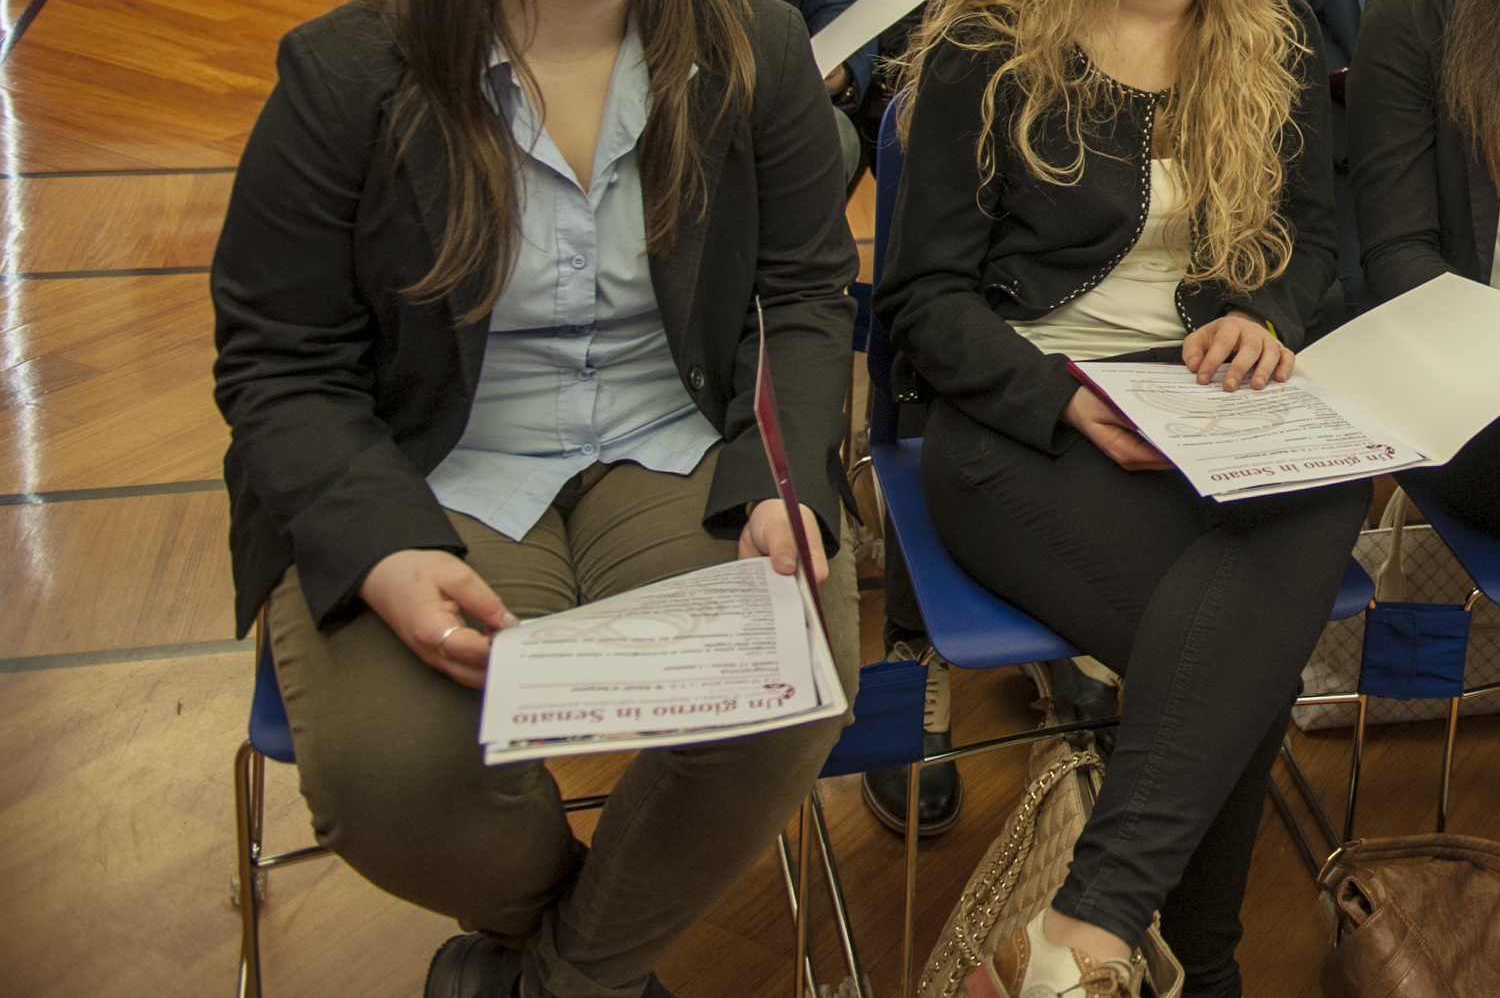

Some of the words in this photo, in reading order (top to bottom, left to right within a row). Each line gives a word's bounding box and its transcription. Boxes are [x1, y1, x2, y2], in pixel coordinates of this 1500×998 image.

[1304, 456, 1361, 469] giorno
[1366, 453, 1394, 461] Un
[1211, 467, 1275, 481] Senato
[1279, 464, 1300, 472] in
[653, 699, 737, 716] giorno
[749, 698, 783, 709] Un
[512, 708, 606, 726] Senato
[616, 707, 642, 721] in
